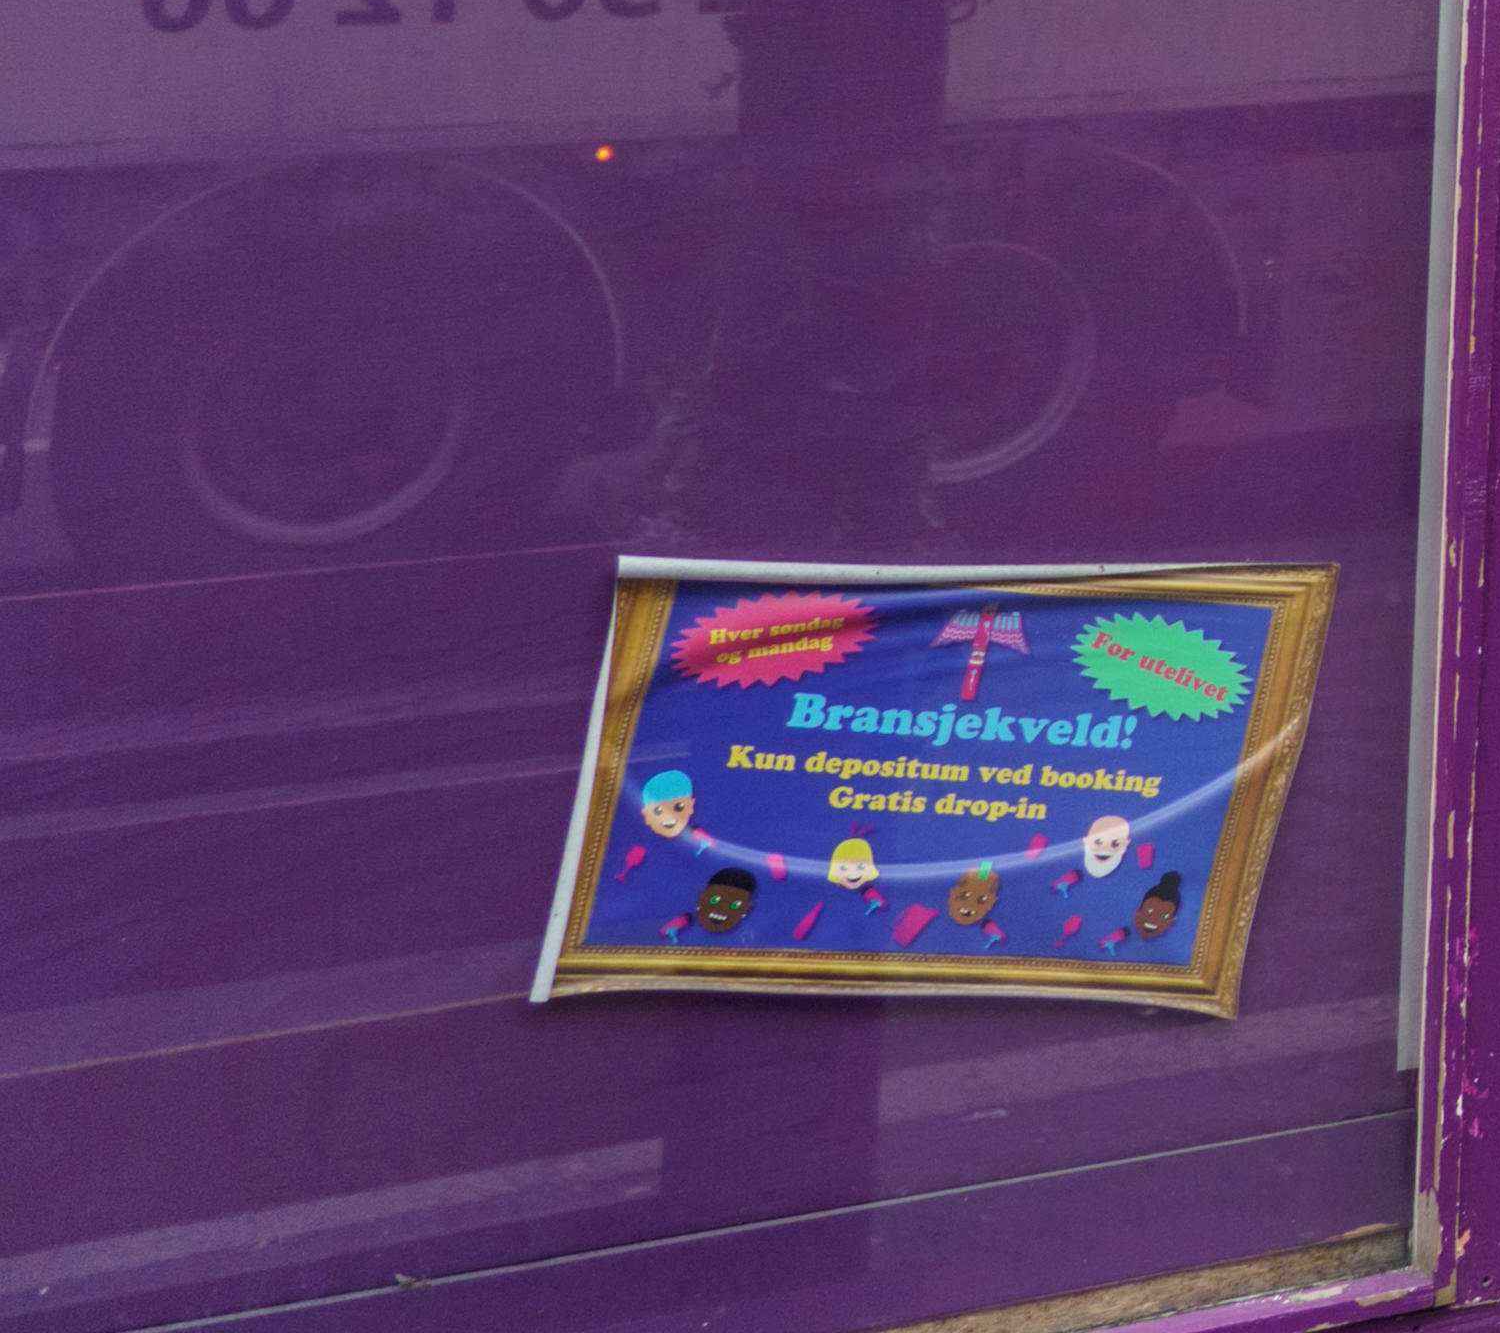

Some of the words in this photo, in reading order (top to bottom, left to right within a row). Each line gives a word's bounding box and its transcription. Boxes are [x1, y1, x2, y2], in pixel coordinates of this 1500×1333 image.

[709, 627, 764, 645] Hver
[769, 617, 845, 637] søndag
[716, 649, 743, 665] og
[747, 635, 834, 659] mandag
[1091, 632, 1136, 661] For
[1138, 654, 1229, 702] utelivet
[786, 692, 1138, 749] Bransjekveld!
[726, 744, 796, 772] Kun
[804, 751, 970, 782] depositum
[978, 763, 1034, 786] ved
[1040, 765, 1162, 798] booking
[828, 785, 928, 813] Gratis
[934, 792, 1047, 822] drop-in
